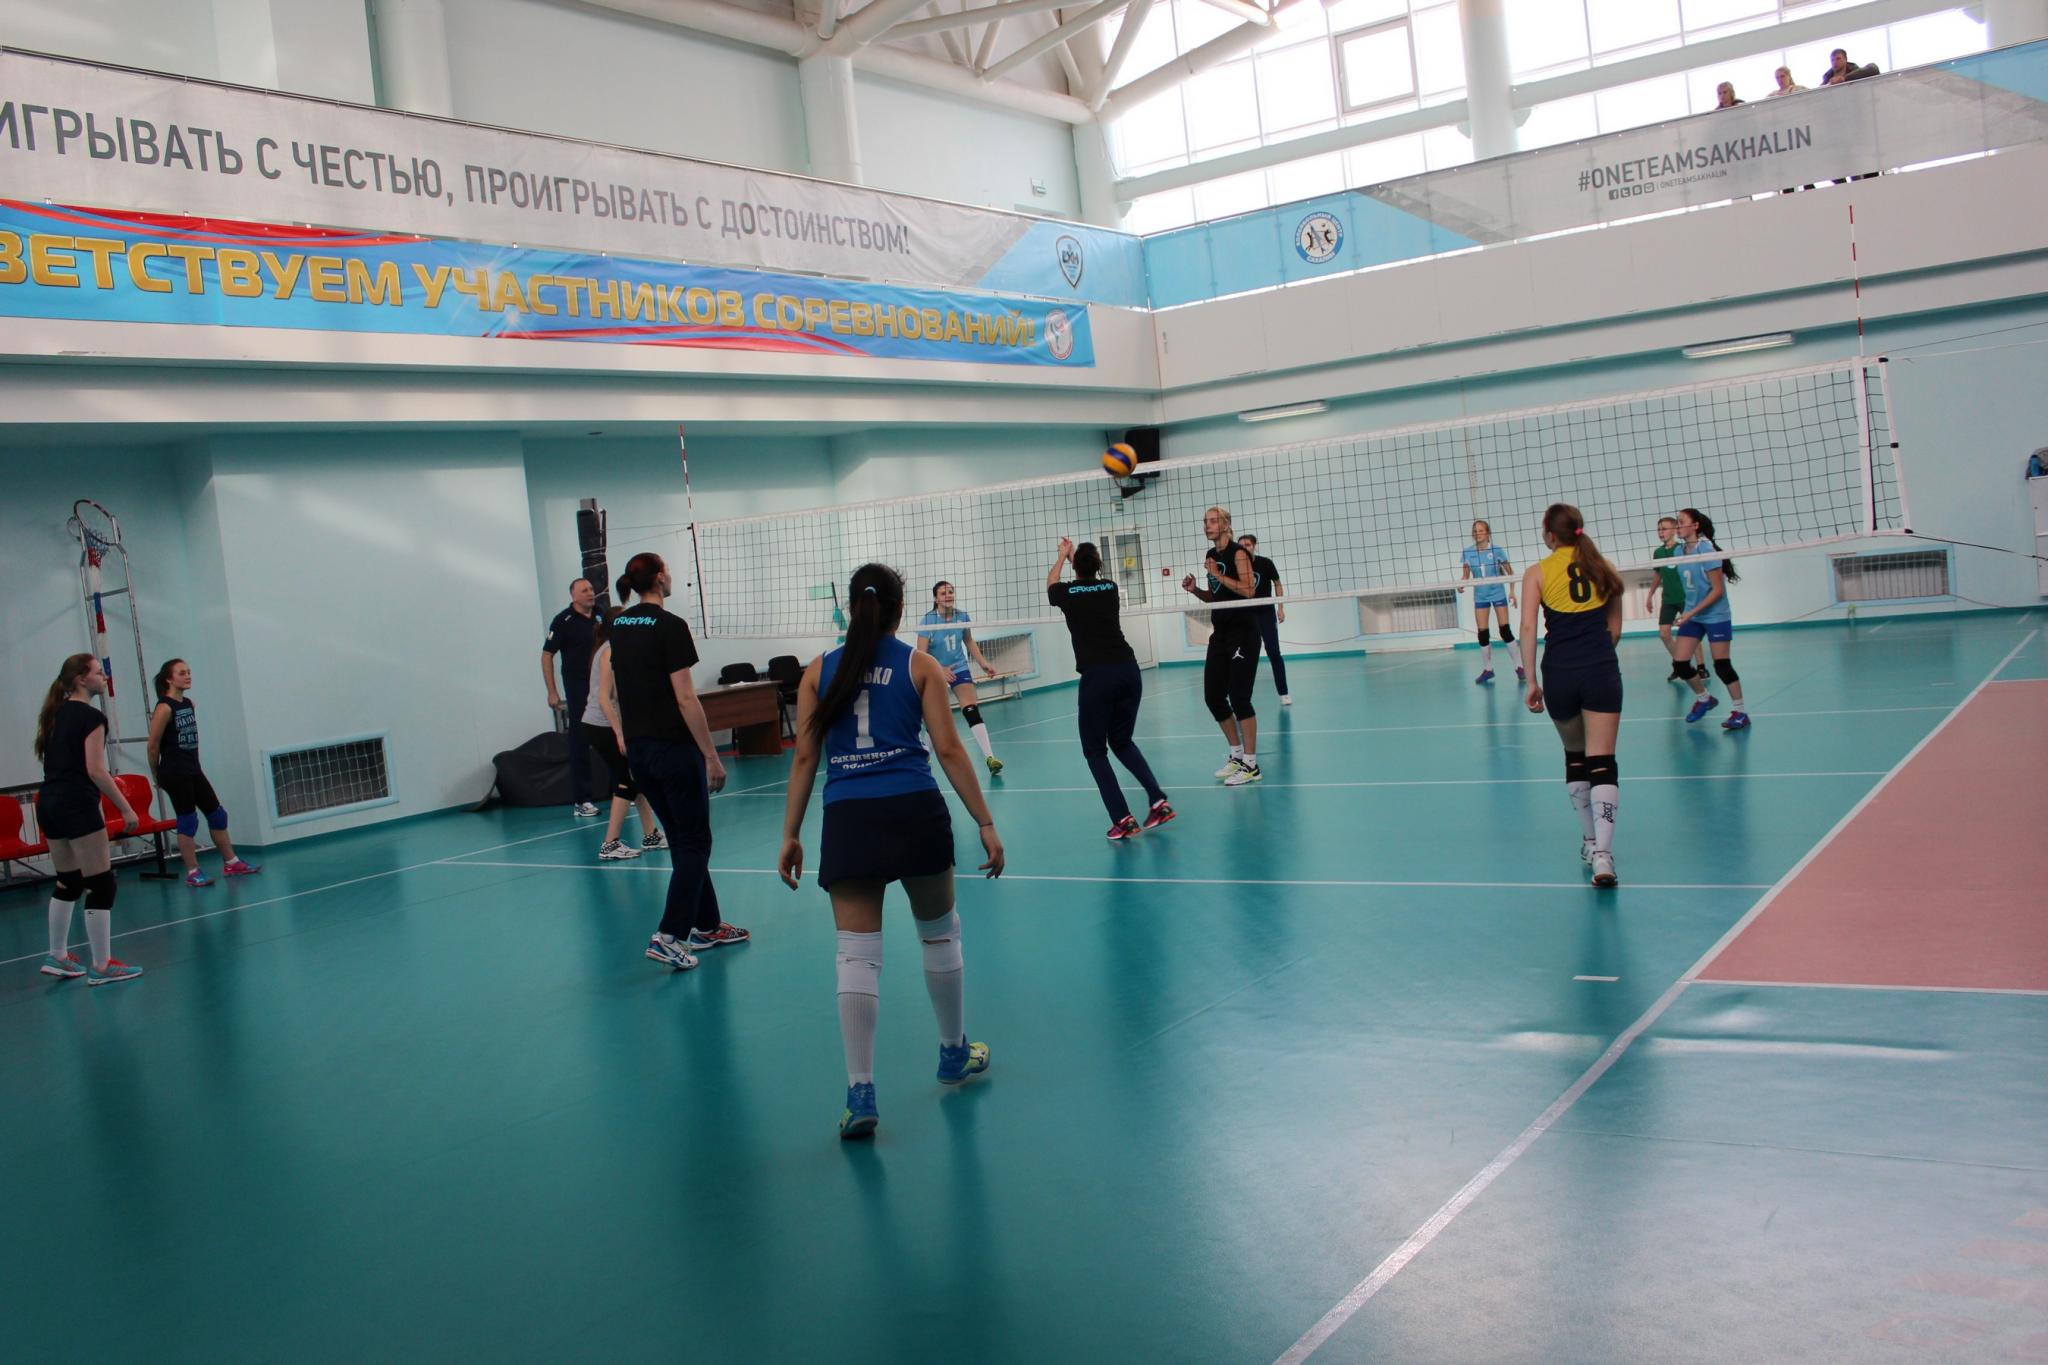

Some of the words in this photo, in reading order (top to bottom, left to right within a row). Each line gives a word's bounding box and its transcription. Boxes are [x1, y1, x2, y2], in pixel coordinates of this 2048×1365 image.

[1578, 125, 1812, 192] #ONETEAMSAKHALIN
[1660, 169, 1728, 189] ONETEAMSAKHALIN
[256, 137, 281, 180] С
[291, 141, 454, 207] ЧЕСТЬЮ,
[464, 164, 689, 227] ПРОИГРЫВАТЬ
[695, 196, 712, 230] С
[721, 199, 911, 255] ДОСТОИНСТВОМ!
[412, 263, 745, 327] УЧАСТНИКОВ
[753, 293, 1036, 348] СОРЕВНОВАНИЙ!
[1567, 562, 1592, 604] 8
[1683, 569, 1695, 588] 2
[944, 634, 957, 652] 11
[853, 689, 875, 749] 1
